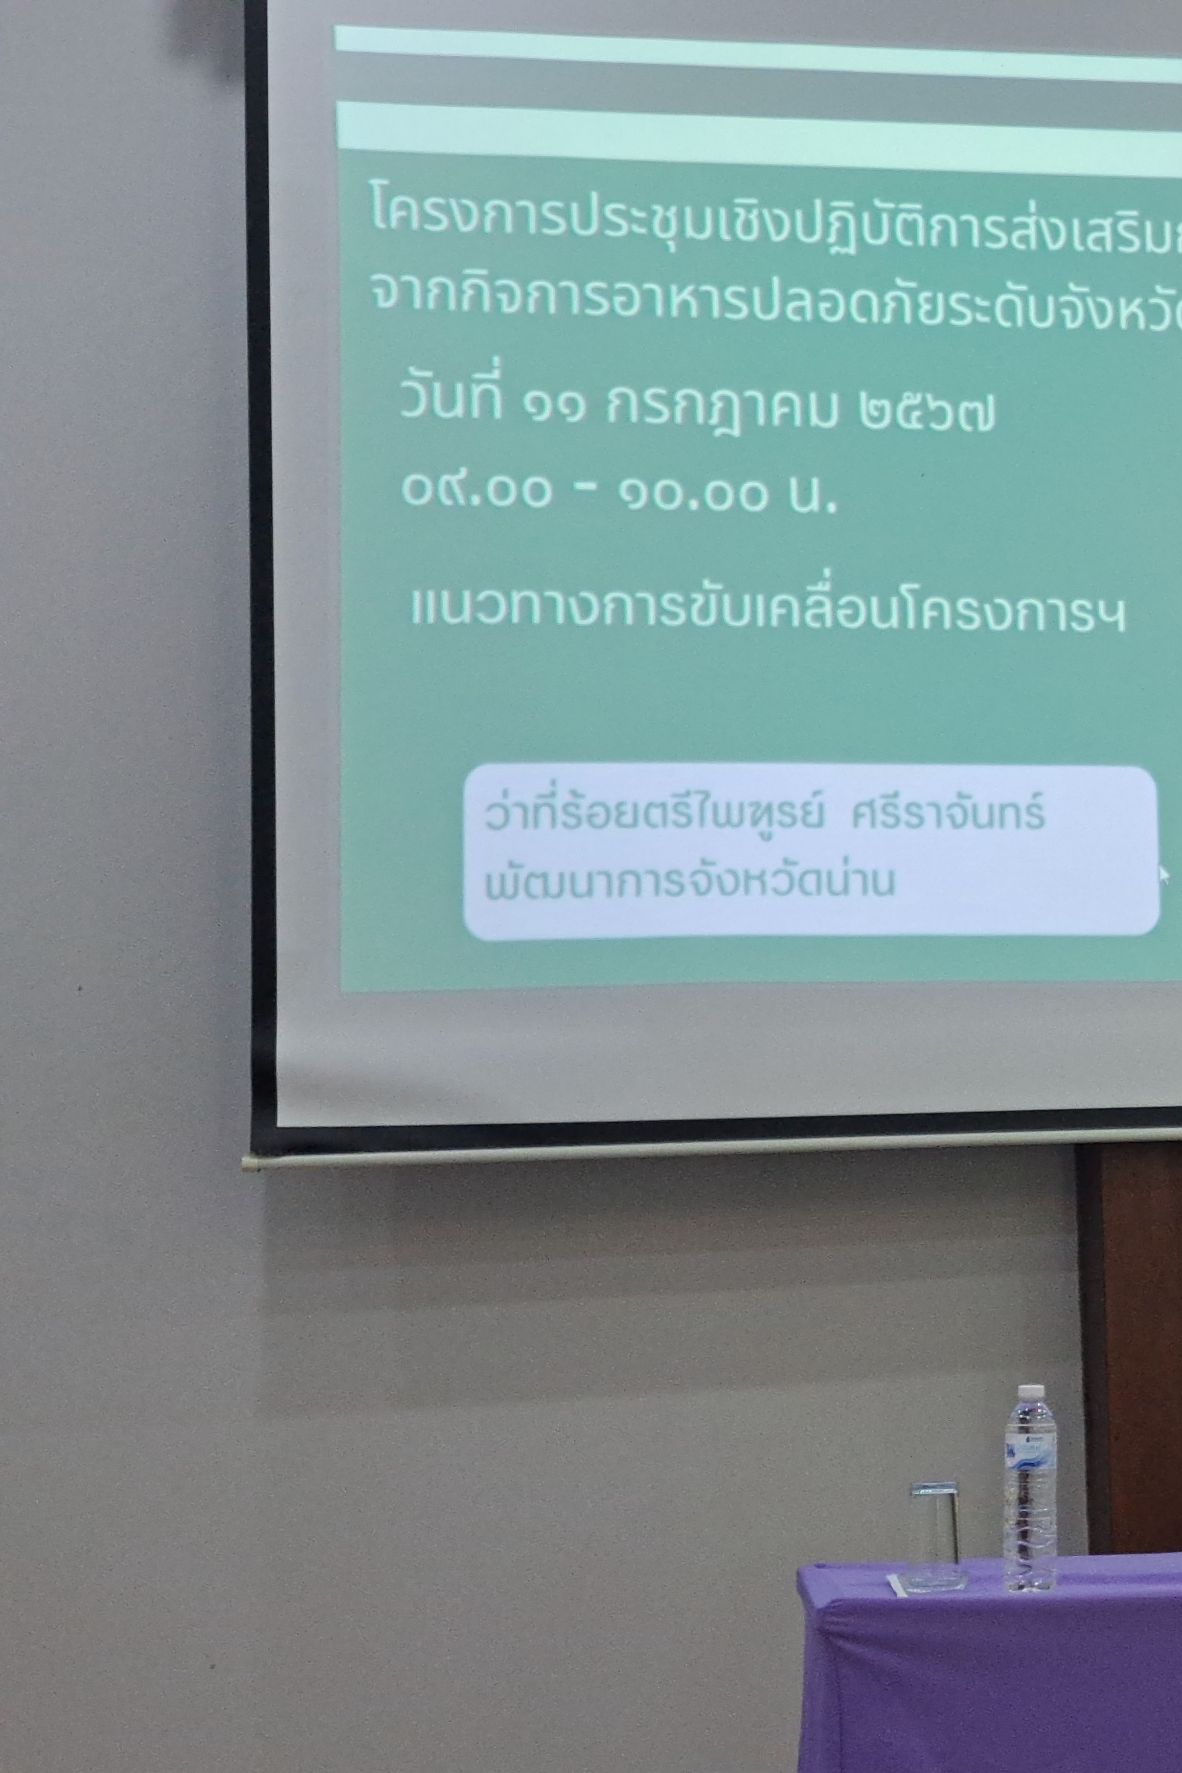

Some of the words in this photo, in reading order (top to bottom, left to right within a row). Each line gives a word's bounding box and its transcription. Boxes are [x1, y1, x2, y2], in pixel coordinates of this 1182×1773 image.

[400, 355, 502, 420] วันที่
[522, 389, 587, 423] ๑๑
[606, 385, 839, 438] กรกฎาคม
[859, 389, 996, 433] ๒๕๖๗
[401, 466, 553, 508] ๐๙.๐๐
[572, 480, 598, 491] -
[618, 477, 770, 512] ๑๐.๐๐
[789, 475, 837, 514] น.
[411, 567, 1128, 632] แนวทางการขับเคลื่อนโครงการฯ
[484, 778, 826, 842] ว่าที่ร้อยตรีไพฑูรย์
[852, 789, 1047, 831] ศรีราจันทร์
[484, 855, 896, 901] พัฒนาการจังหวัดน่าน
